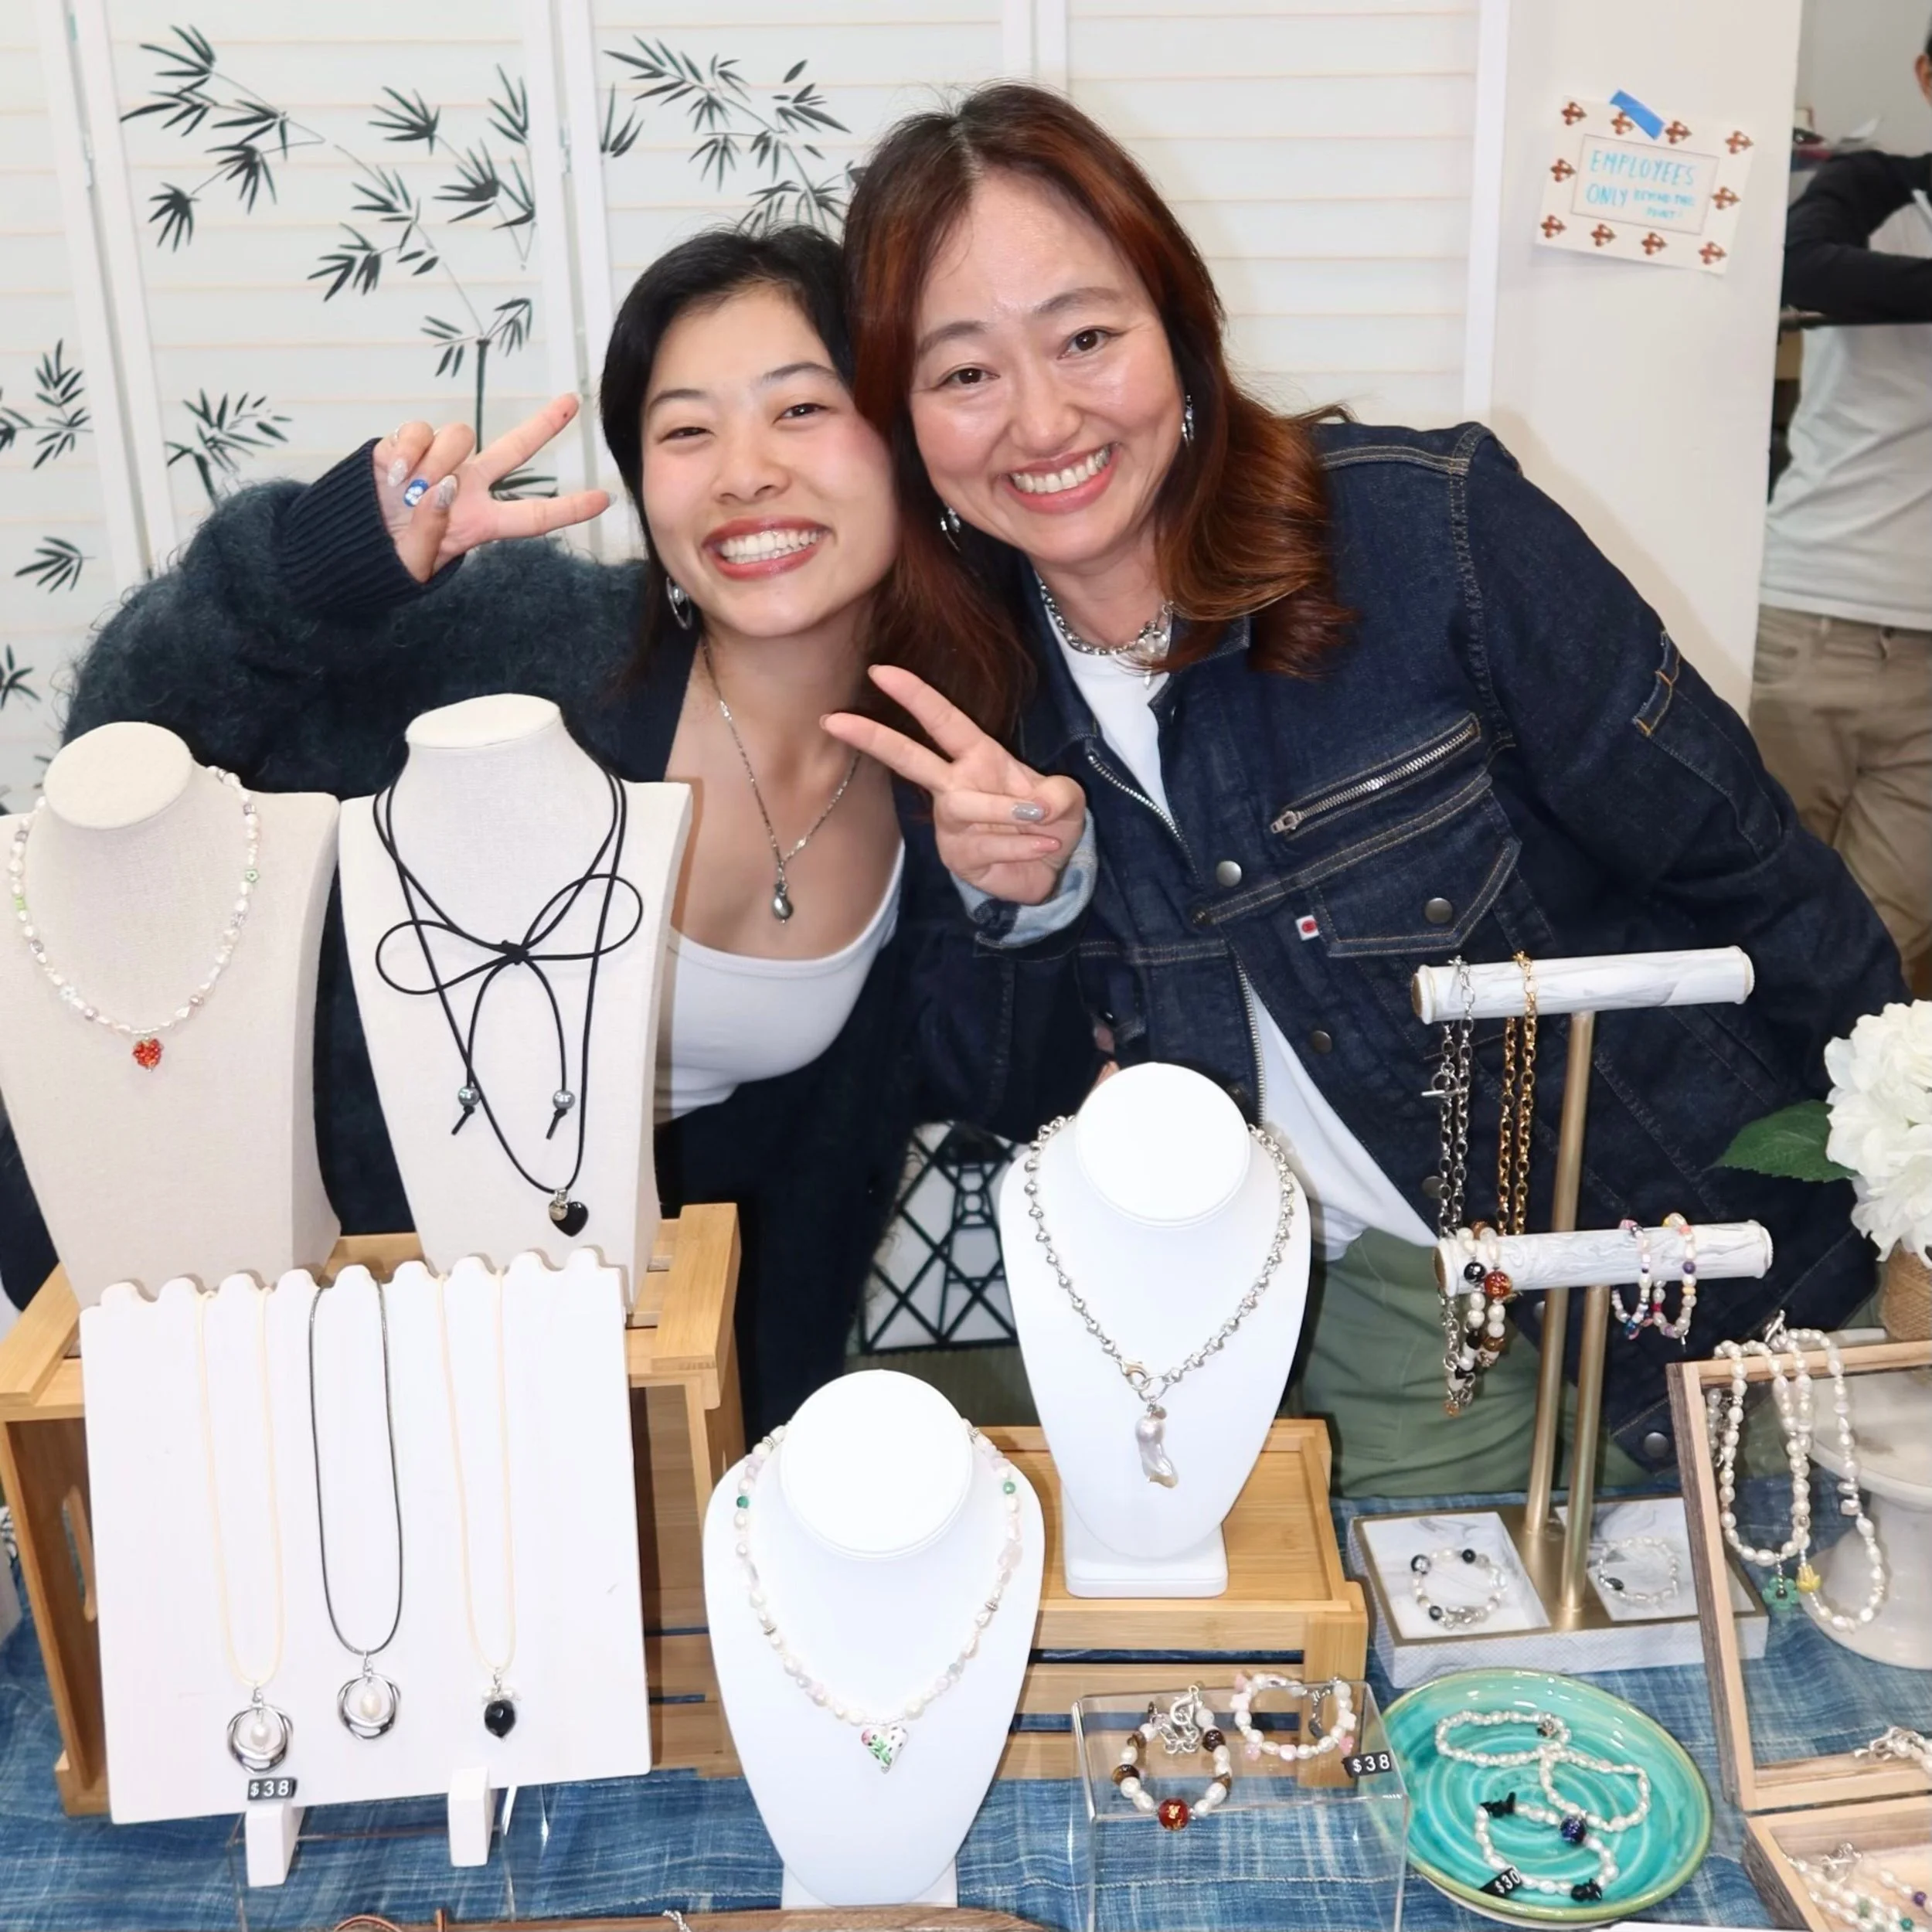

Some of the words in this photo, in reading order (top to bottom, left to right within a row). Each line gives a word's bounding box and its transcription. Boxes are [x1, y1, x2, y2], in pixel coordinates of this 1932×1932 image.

[1590, 149, 1696, 185] EMPLOYEES
[1586, 183, 1628, 207] ONLY
[1353, 1753, 1390, 1773] $38
[250, 1780, 289, 1798] $38
[1495, 1869, 1521, 1894] $30
